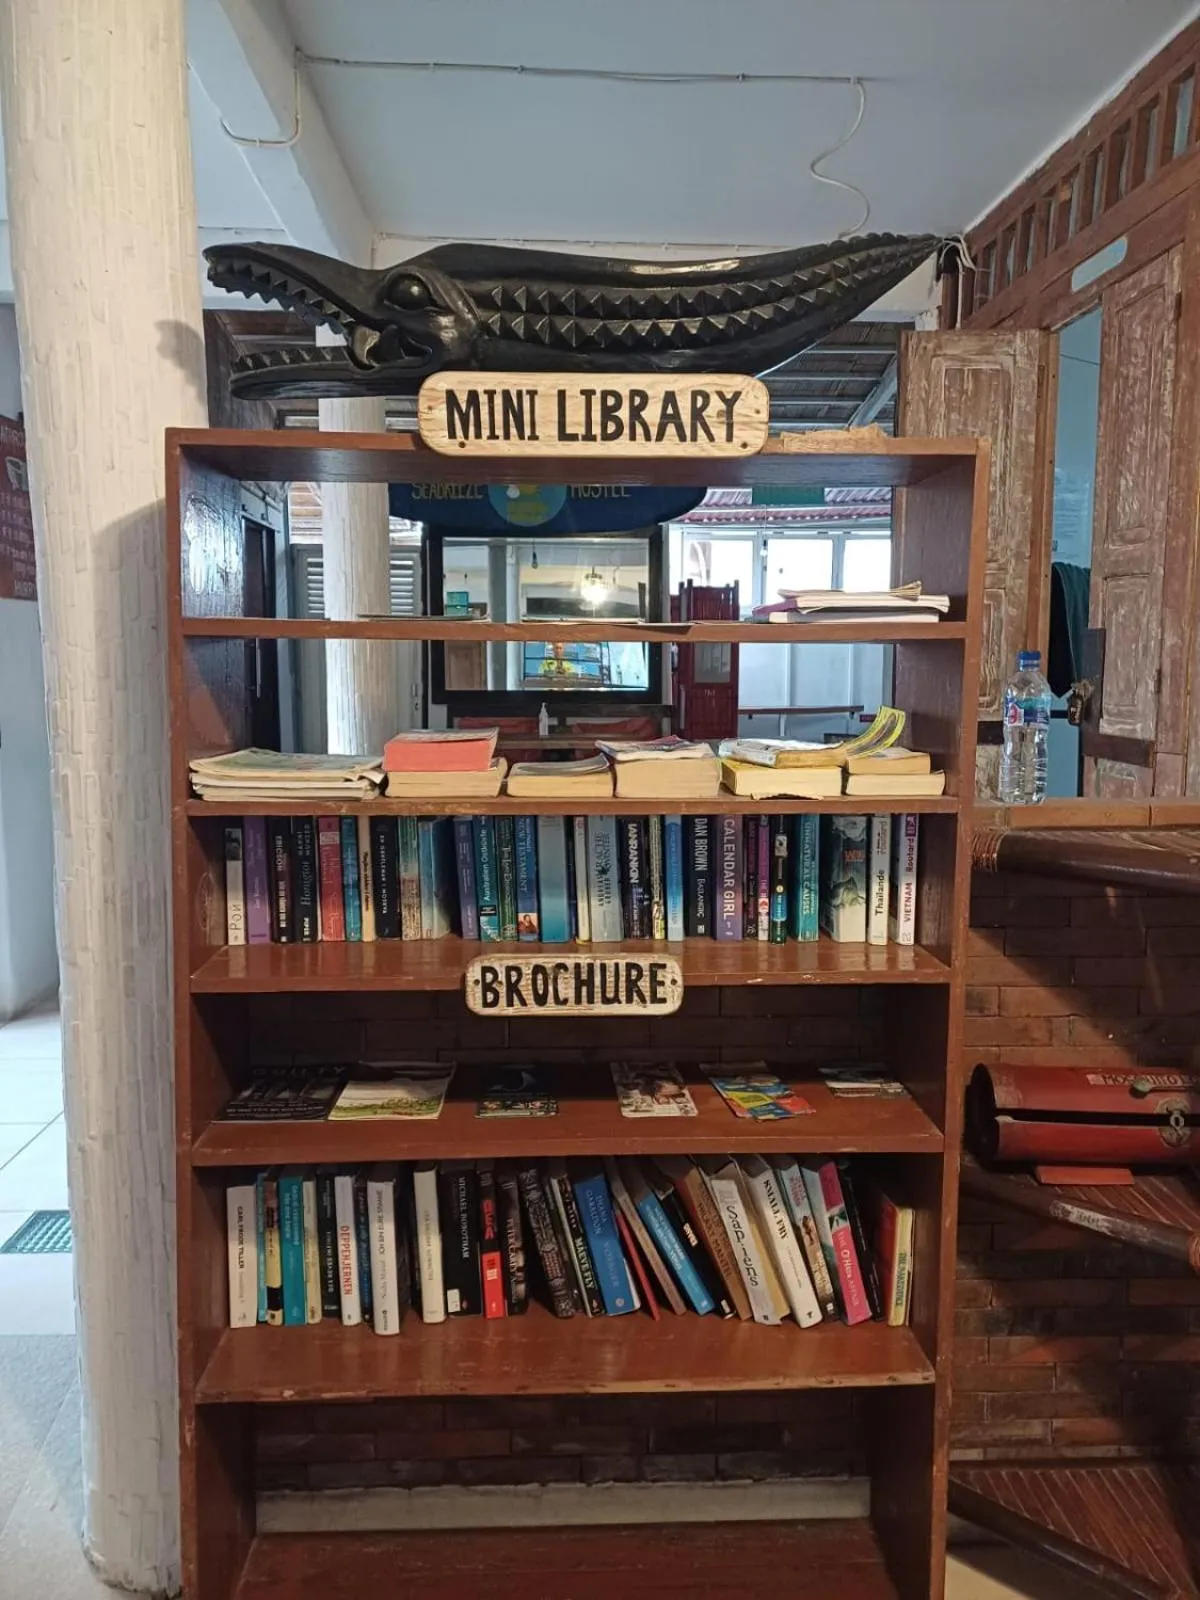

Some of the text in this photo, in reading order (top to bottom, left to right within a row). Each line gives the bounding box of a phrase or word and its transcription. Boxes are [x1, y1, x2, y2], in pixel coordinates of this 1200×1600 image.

[445, 388, 742, 443] MINI LIBRARY
[694, 817, 708, 838] DAN
[694, 838, 708, 872] BROWN
[723, 819, 736, 920] CALENDAR GIRL
[802, 880, 810, 916] CAUSES
[903, 882, 913, 923] VIETNAM
[481, 962, 668, 1009] BROCHURE
[763, 1179, 789, 1240] SMALL FRY
[461, 1213, 470, 1259] ROBOTHAM
[574, 1236, 596, 1289] MAEVE FLY
